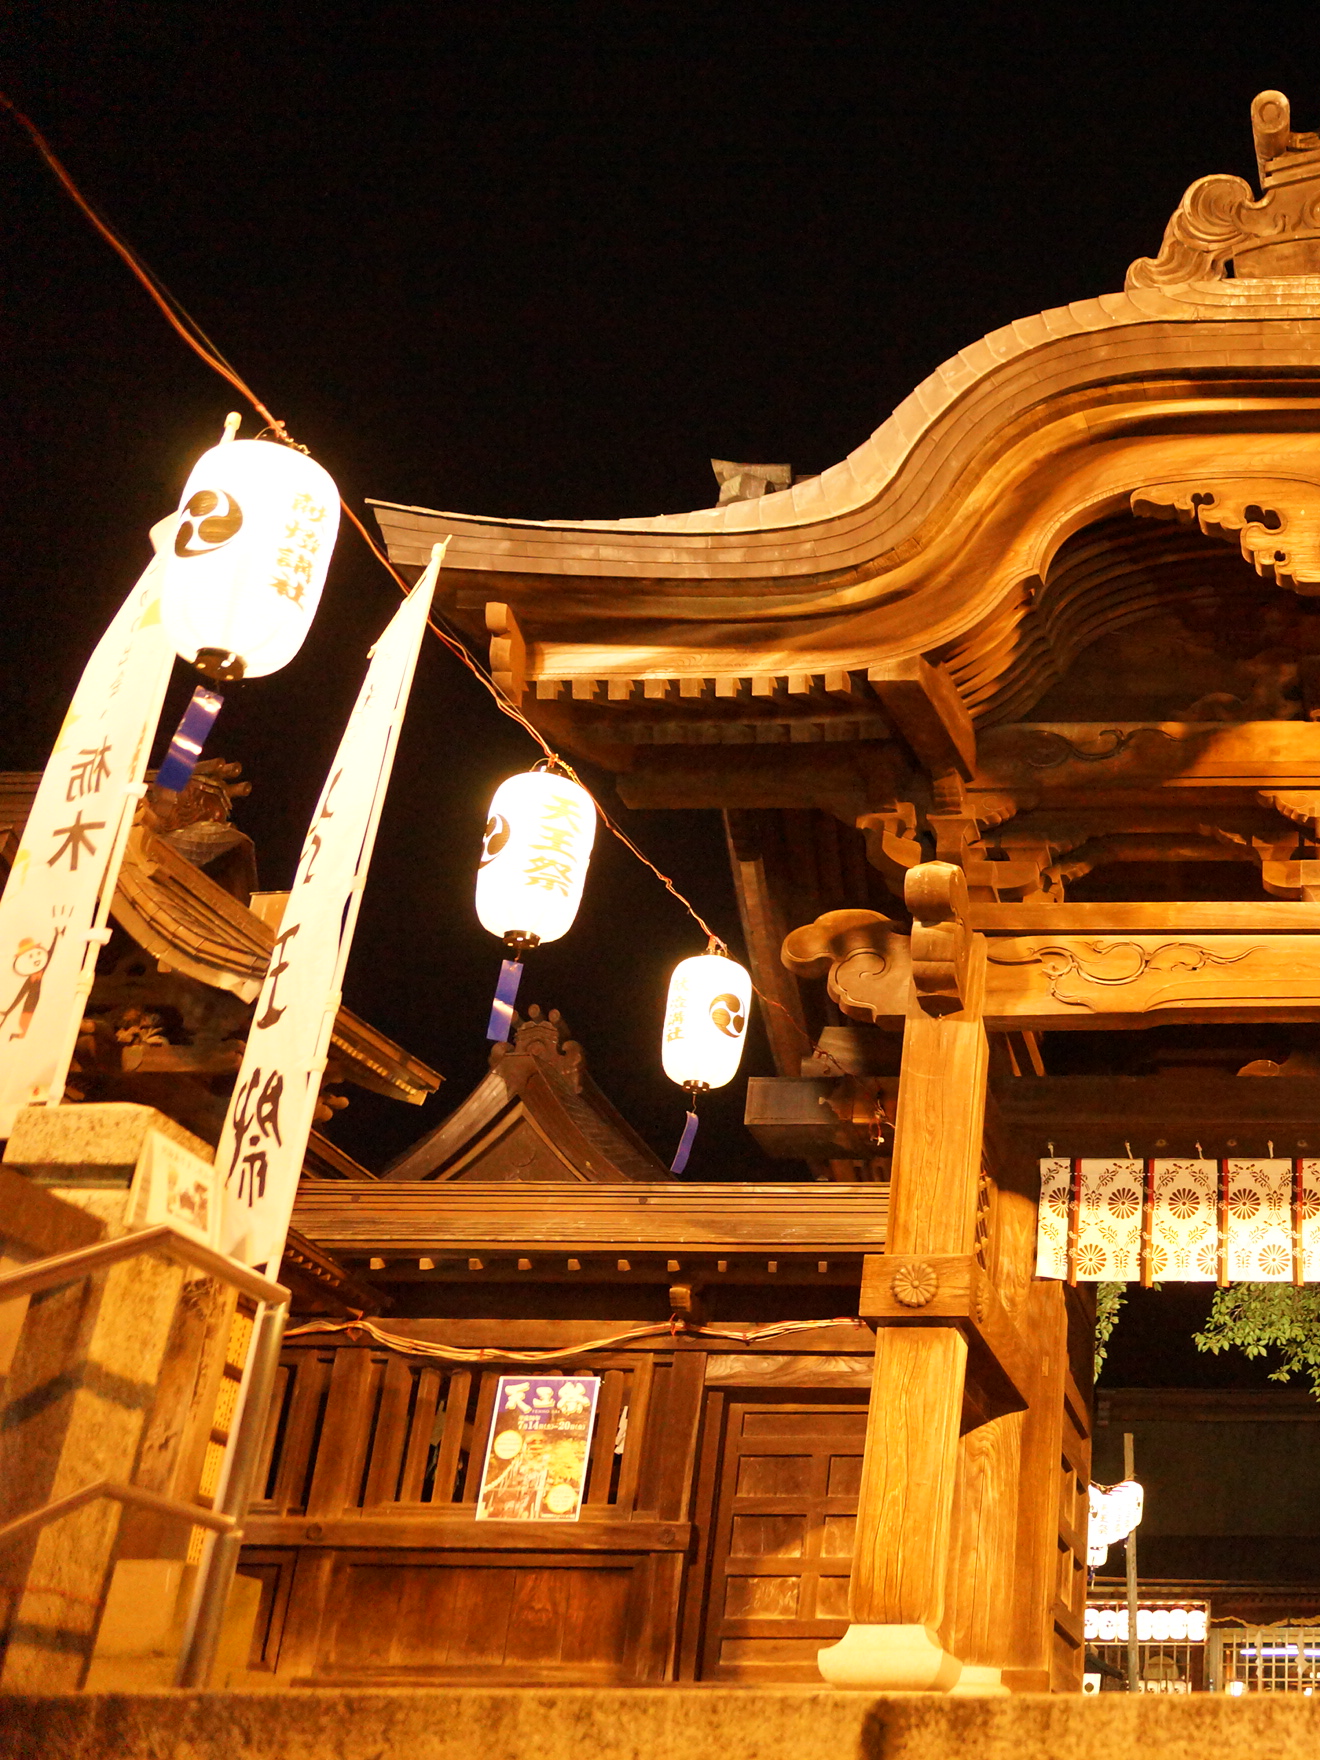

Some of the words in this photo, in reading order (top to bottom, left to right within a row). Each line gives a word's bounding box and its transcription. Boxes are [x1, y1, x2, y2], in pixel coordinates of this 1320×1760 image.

[523, 794, 583, 898] 天王祭
[504, 1381, 591, 1415] 天王祭
